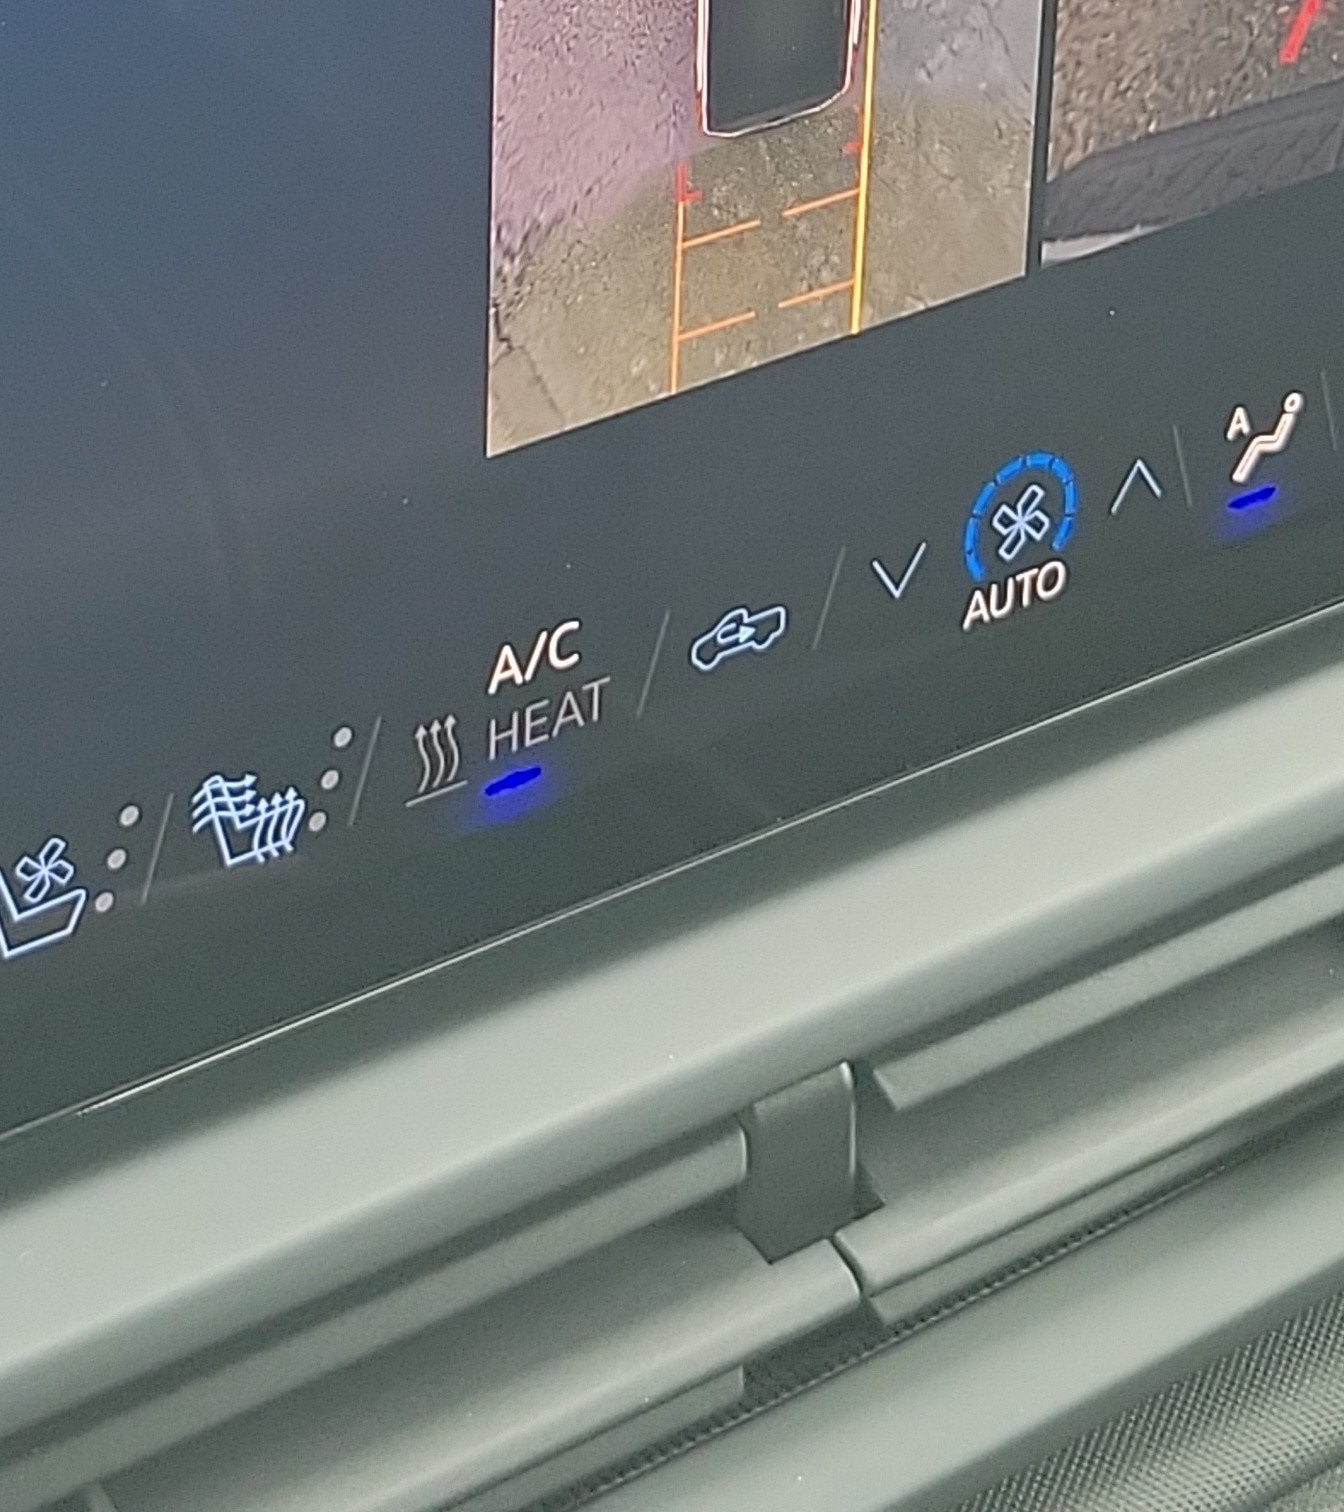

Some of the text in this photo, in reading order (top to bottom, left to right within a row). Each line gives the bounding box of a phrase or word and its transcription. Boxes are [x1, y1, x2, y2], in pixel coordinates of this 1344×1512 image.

[1225, 406, 1250, 441] A
[963, 561, 1067, 630] AUTO
[488, 621, 582, 695] A/C
[488, 677, 611, 761] HEAT
